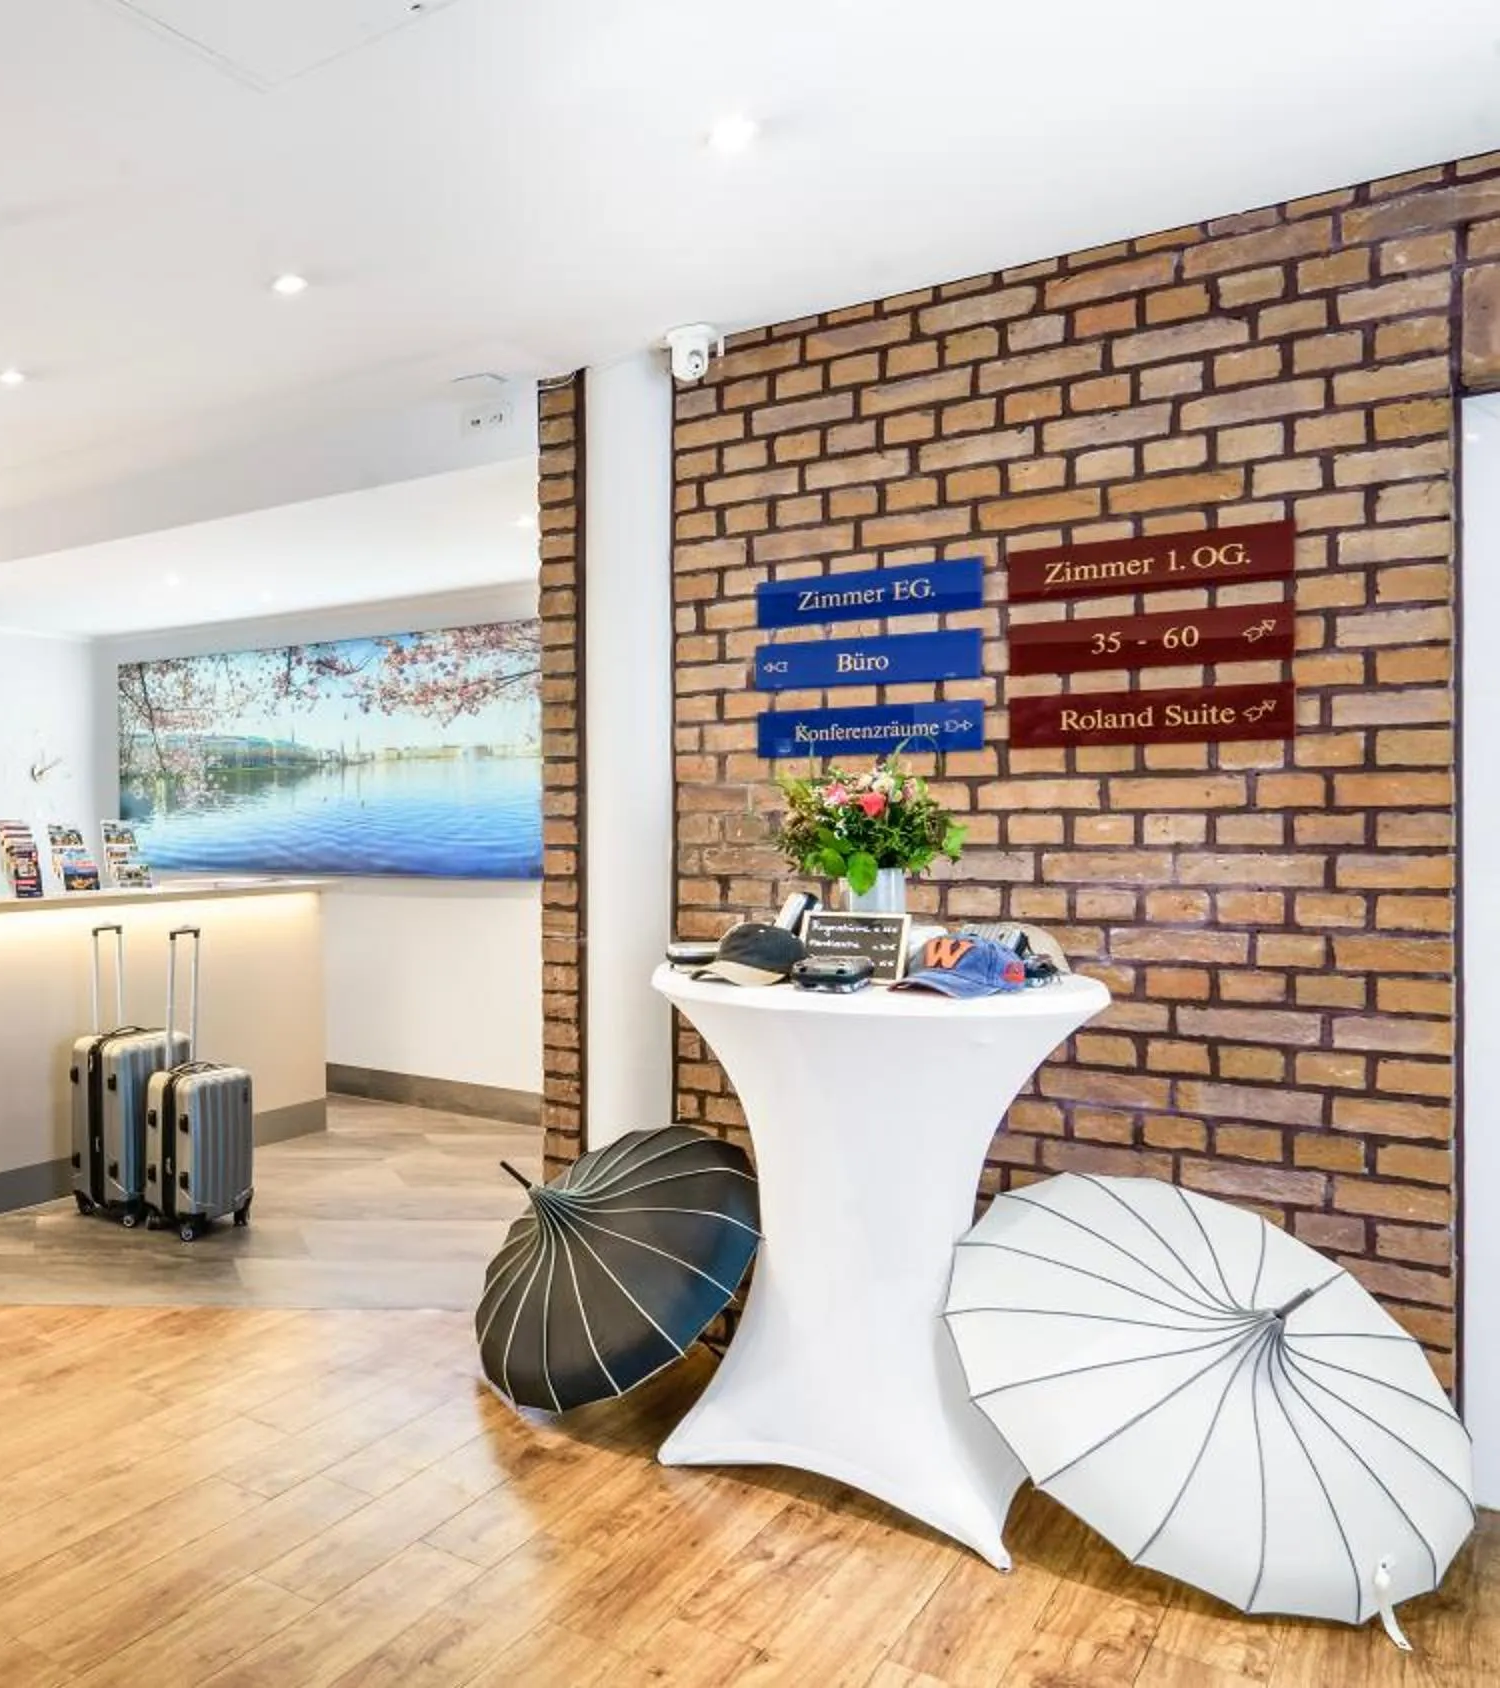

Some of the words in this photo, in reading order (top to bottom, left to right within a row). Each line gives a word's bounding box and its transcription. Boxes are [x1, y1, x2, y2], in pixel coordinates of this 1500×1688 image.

[1043, 557, 1155, 585] Zimmer
[1167, 550, 1186, 572] 1.
[1191, 543, 1252, 569] OG.
[797, 586, 887, 611] Zimmer
[891, 577, 937, 601] EG.
[1091, 630, 1123, 655] 35
[1162, 625, 1200, 649] 60
[835, 652, 889, 673] Büro
[794, 721, 940, 743] Konferenzräume
[1059, 706, 1154, 731] Roland
[1164, 703, 1237, 727] Suite
[923, 935, 978, 970] W
